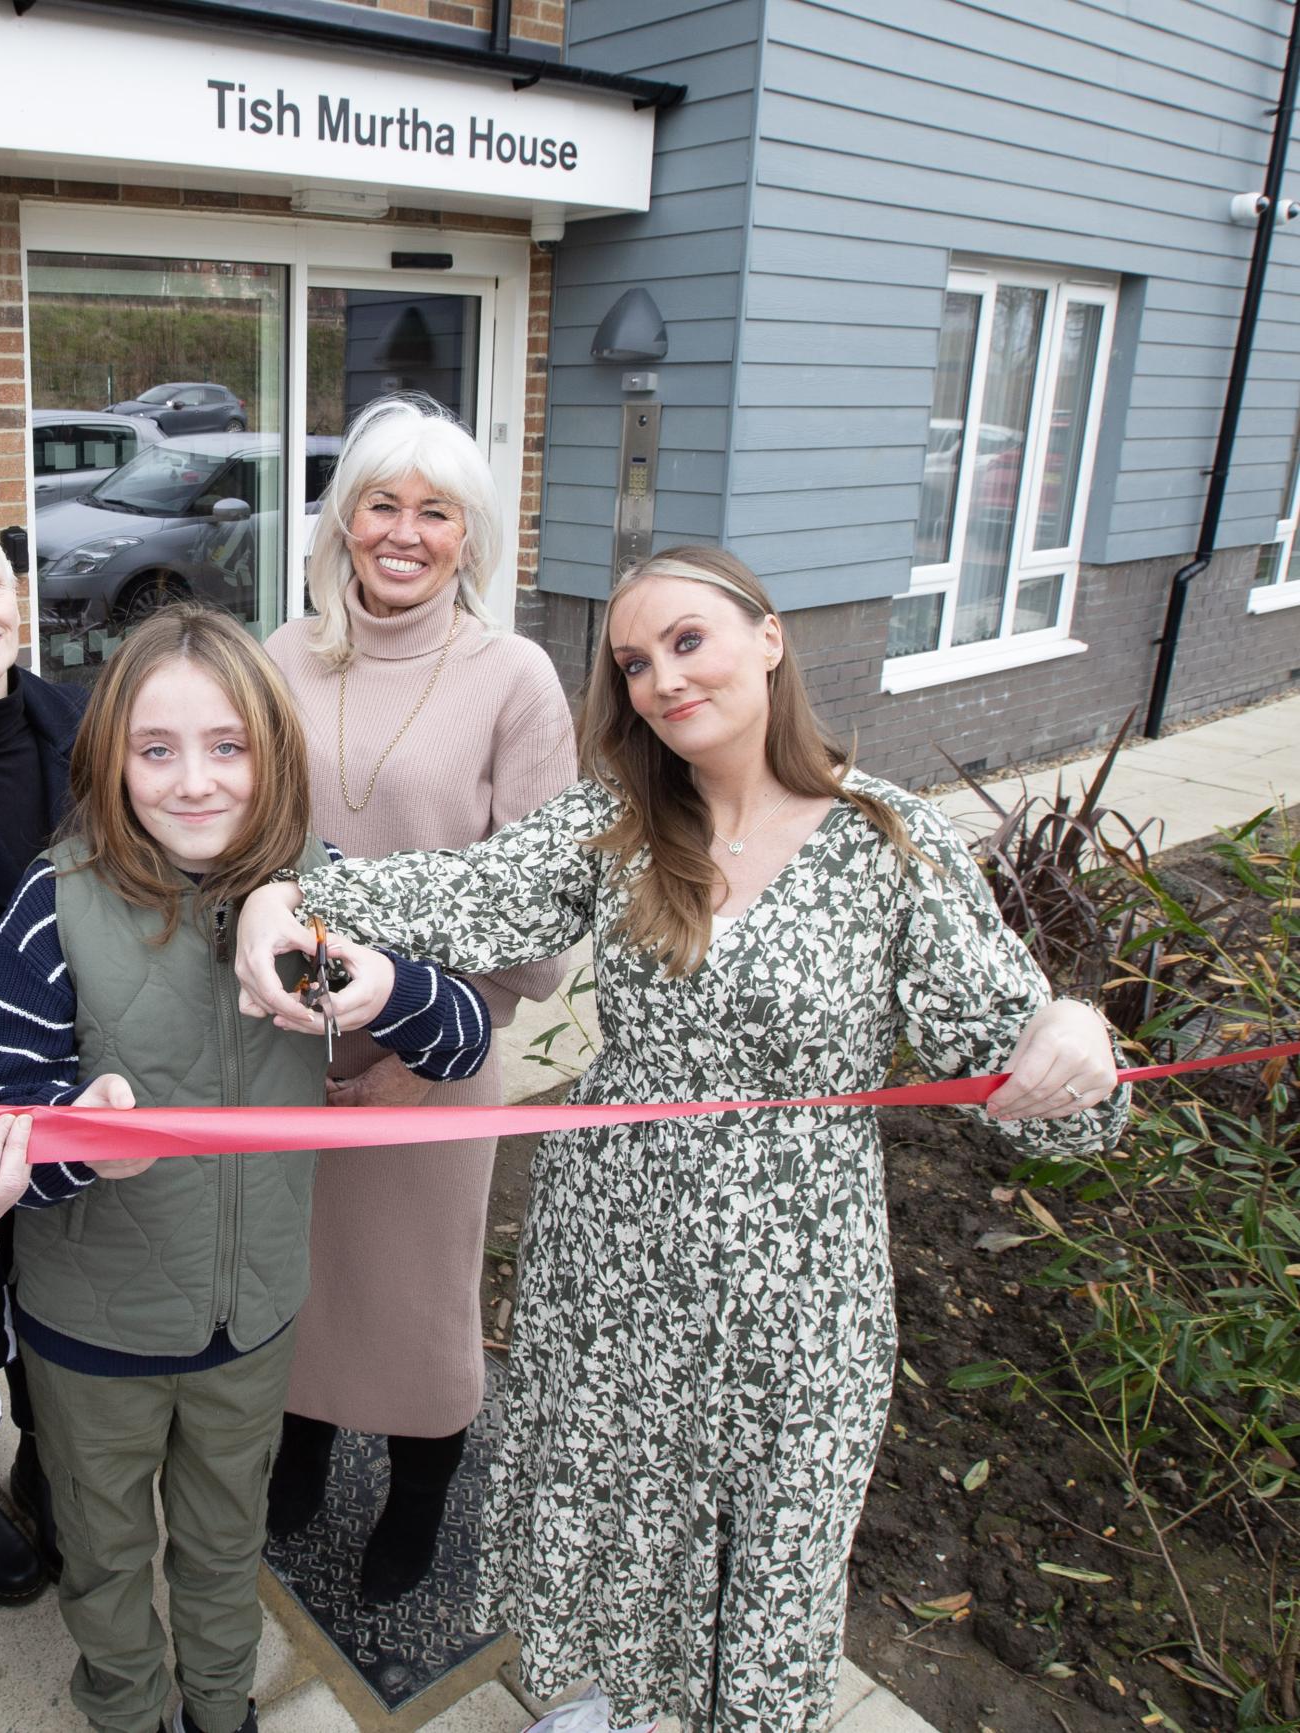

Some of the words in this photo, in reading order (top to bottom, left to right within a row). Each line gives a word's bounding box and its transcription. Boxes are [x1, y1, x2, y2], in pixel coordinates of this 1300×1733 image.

[207, 79, 300, 138] Tish
[318, 95, 455, 156] Murtha
[469, 116, 578, 171] House
